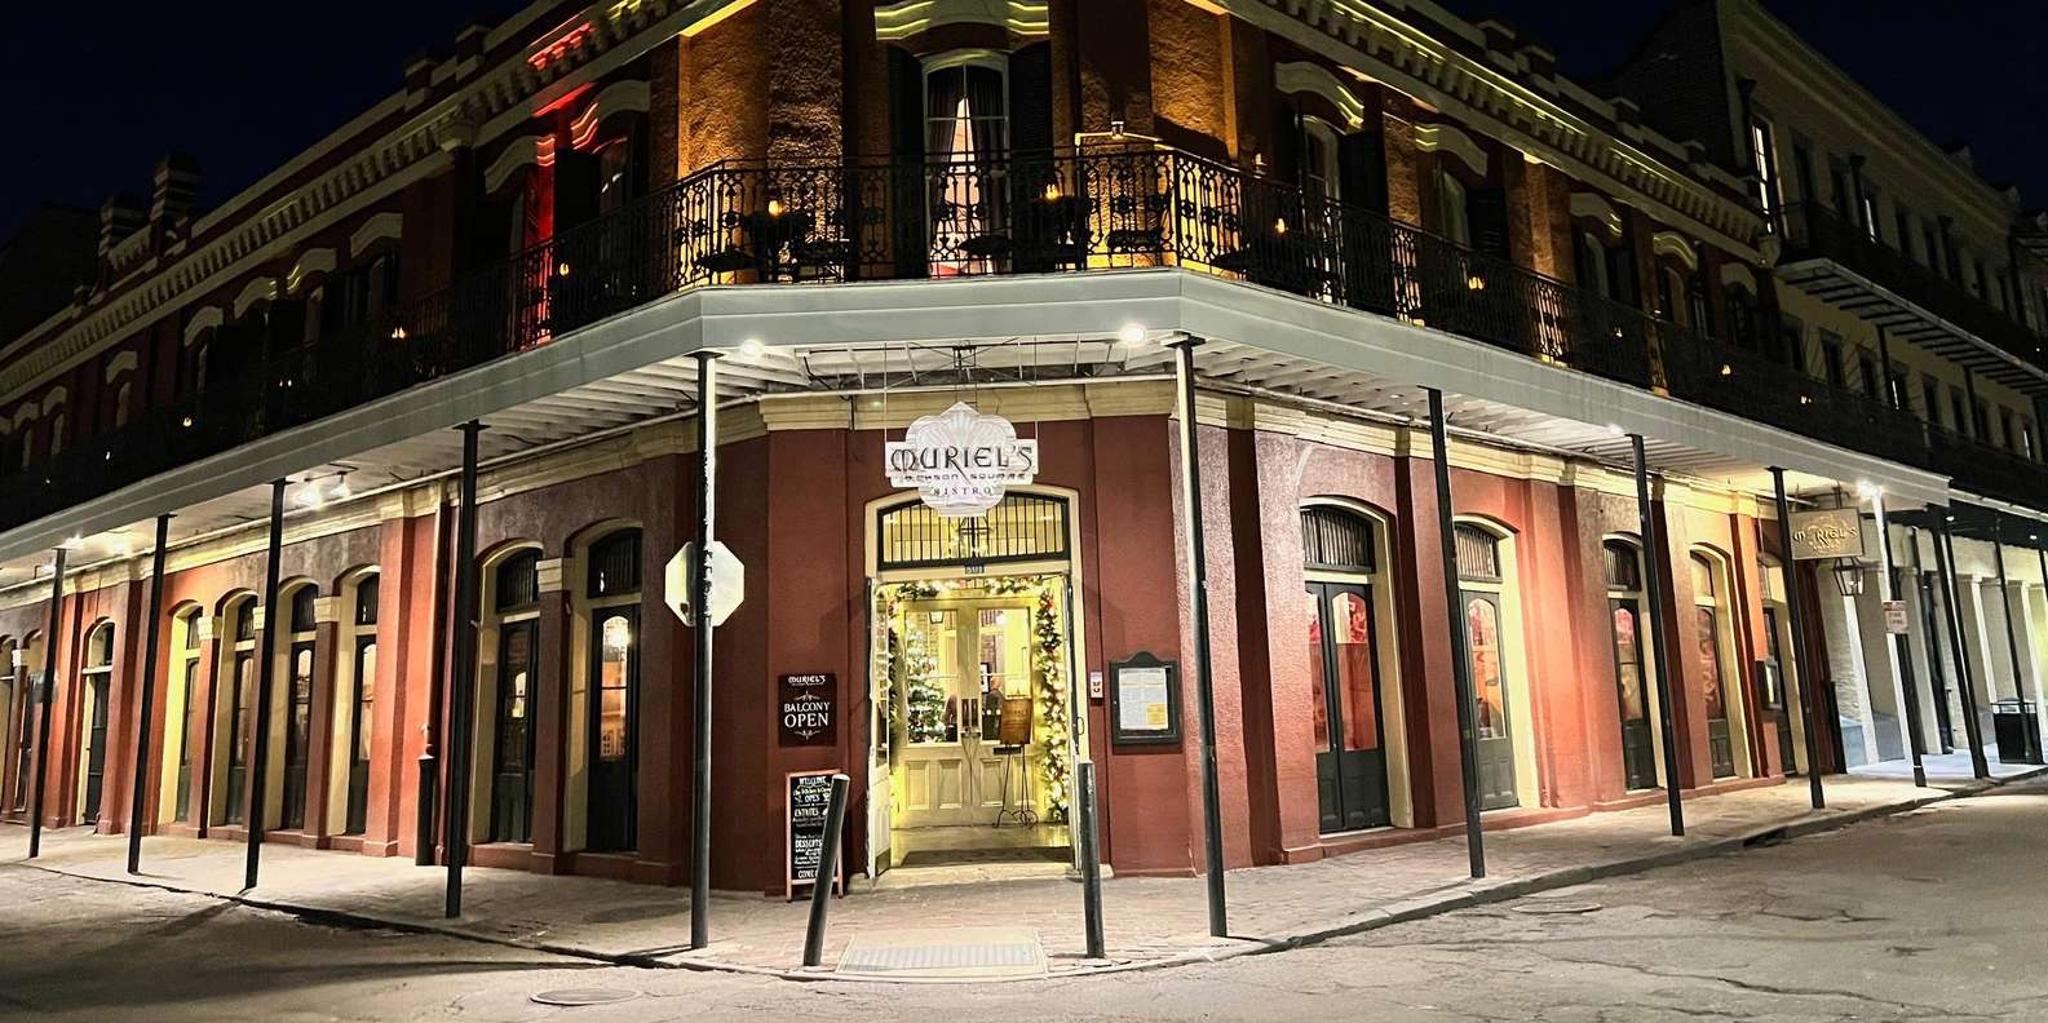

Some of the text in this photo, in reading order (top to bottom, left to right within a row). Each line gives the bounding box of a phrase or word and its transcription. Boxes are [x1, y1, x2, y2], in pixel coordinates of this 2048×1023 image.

[890, 445, 1033, 478] MURIEL'S
[899, 472, 1026, 482] ACKSON SQUARE
[933, 486, 993, 497] BISTRO
[783, 701, 831, 713] BALCONY
[783, 712, 829, 728] OPEN
